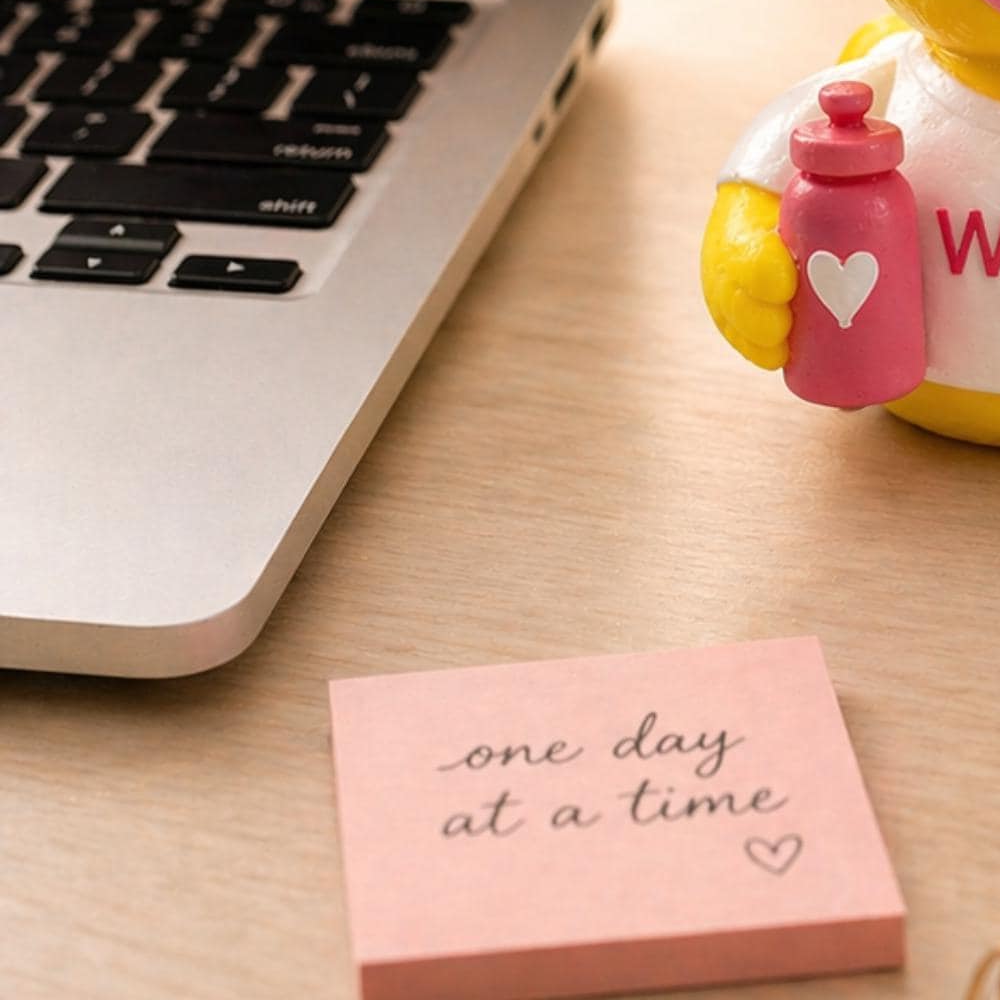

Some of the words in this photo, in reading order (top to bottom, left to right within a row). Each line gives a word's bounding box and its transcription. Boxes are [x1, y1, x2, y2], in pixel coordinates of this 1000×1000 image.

[272, 143, 353, 160] return
[258, 198, 317, 214] shift
[437, 739, 584, 772] one
[612, 711, 746, 779] day
[441, 790, 526, 838] at
[550, 803, 602, 829] a
[618, 776, 789, 826] time
